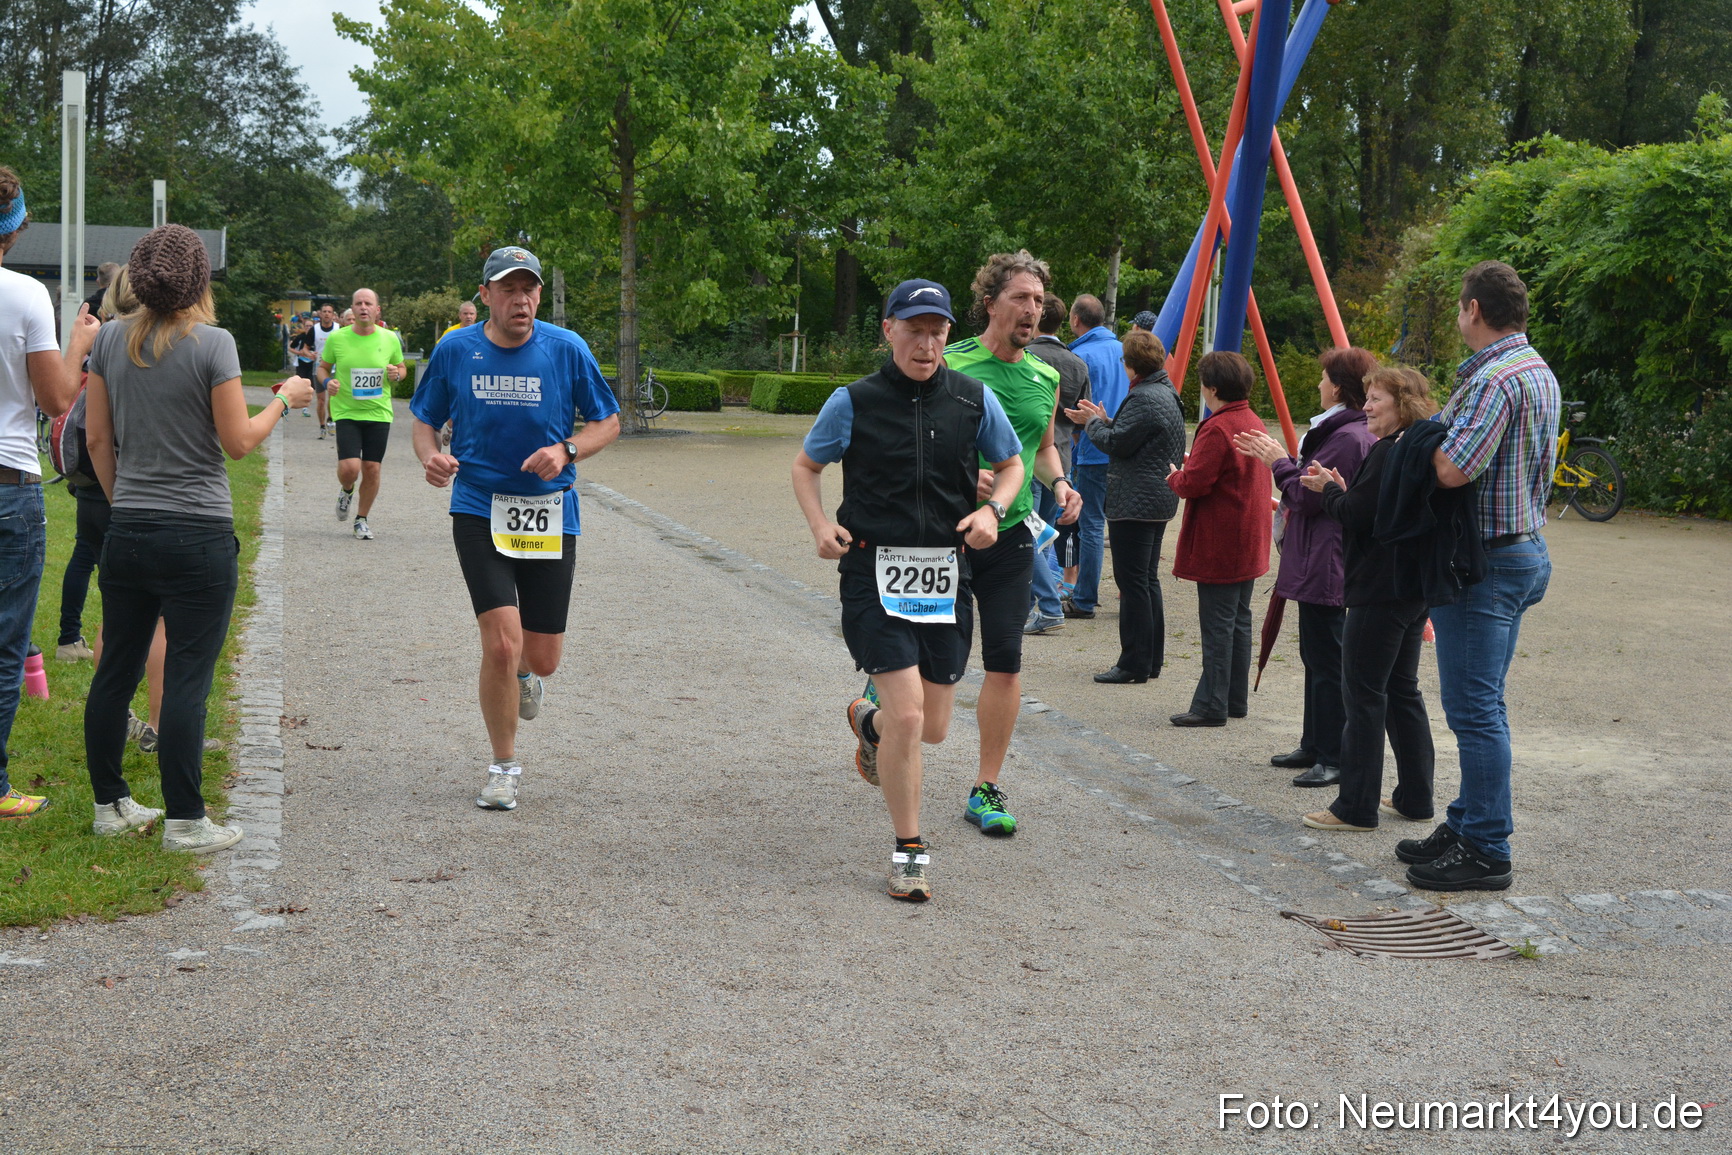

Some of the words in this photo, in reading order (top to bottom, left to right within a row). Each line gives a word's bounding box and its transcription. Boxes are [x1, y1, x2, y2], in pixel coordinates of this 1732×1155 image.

[355, 376, 381, 387] 2202
[472, 375, 541, 392] HUBER
[494, 495, 518, 504] PARTL
[507, 507, 549, 532] 326
[511, 538, 544, 549] Werner
[879, 554, 907, 562] PARTL
[885, 566, 951, 594] 2295
[898, 602, 938, 613] Michael
